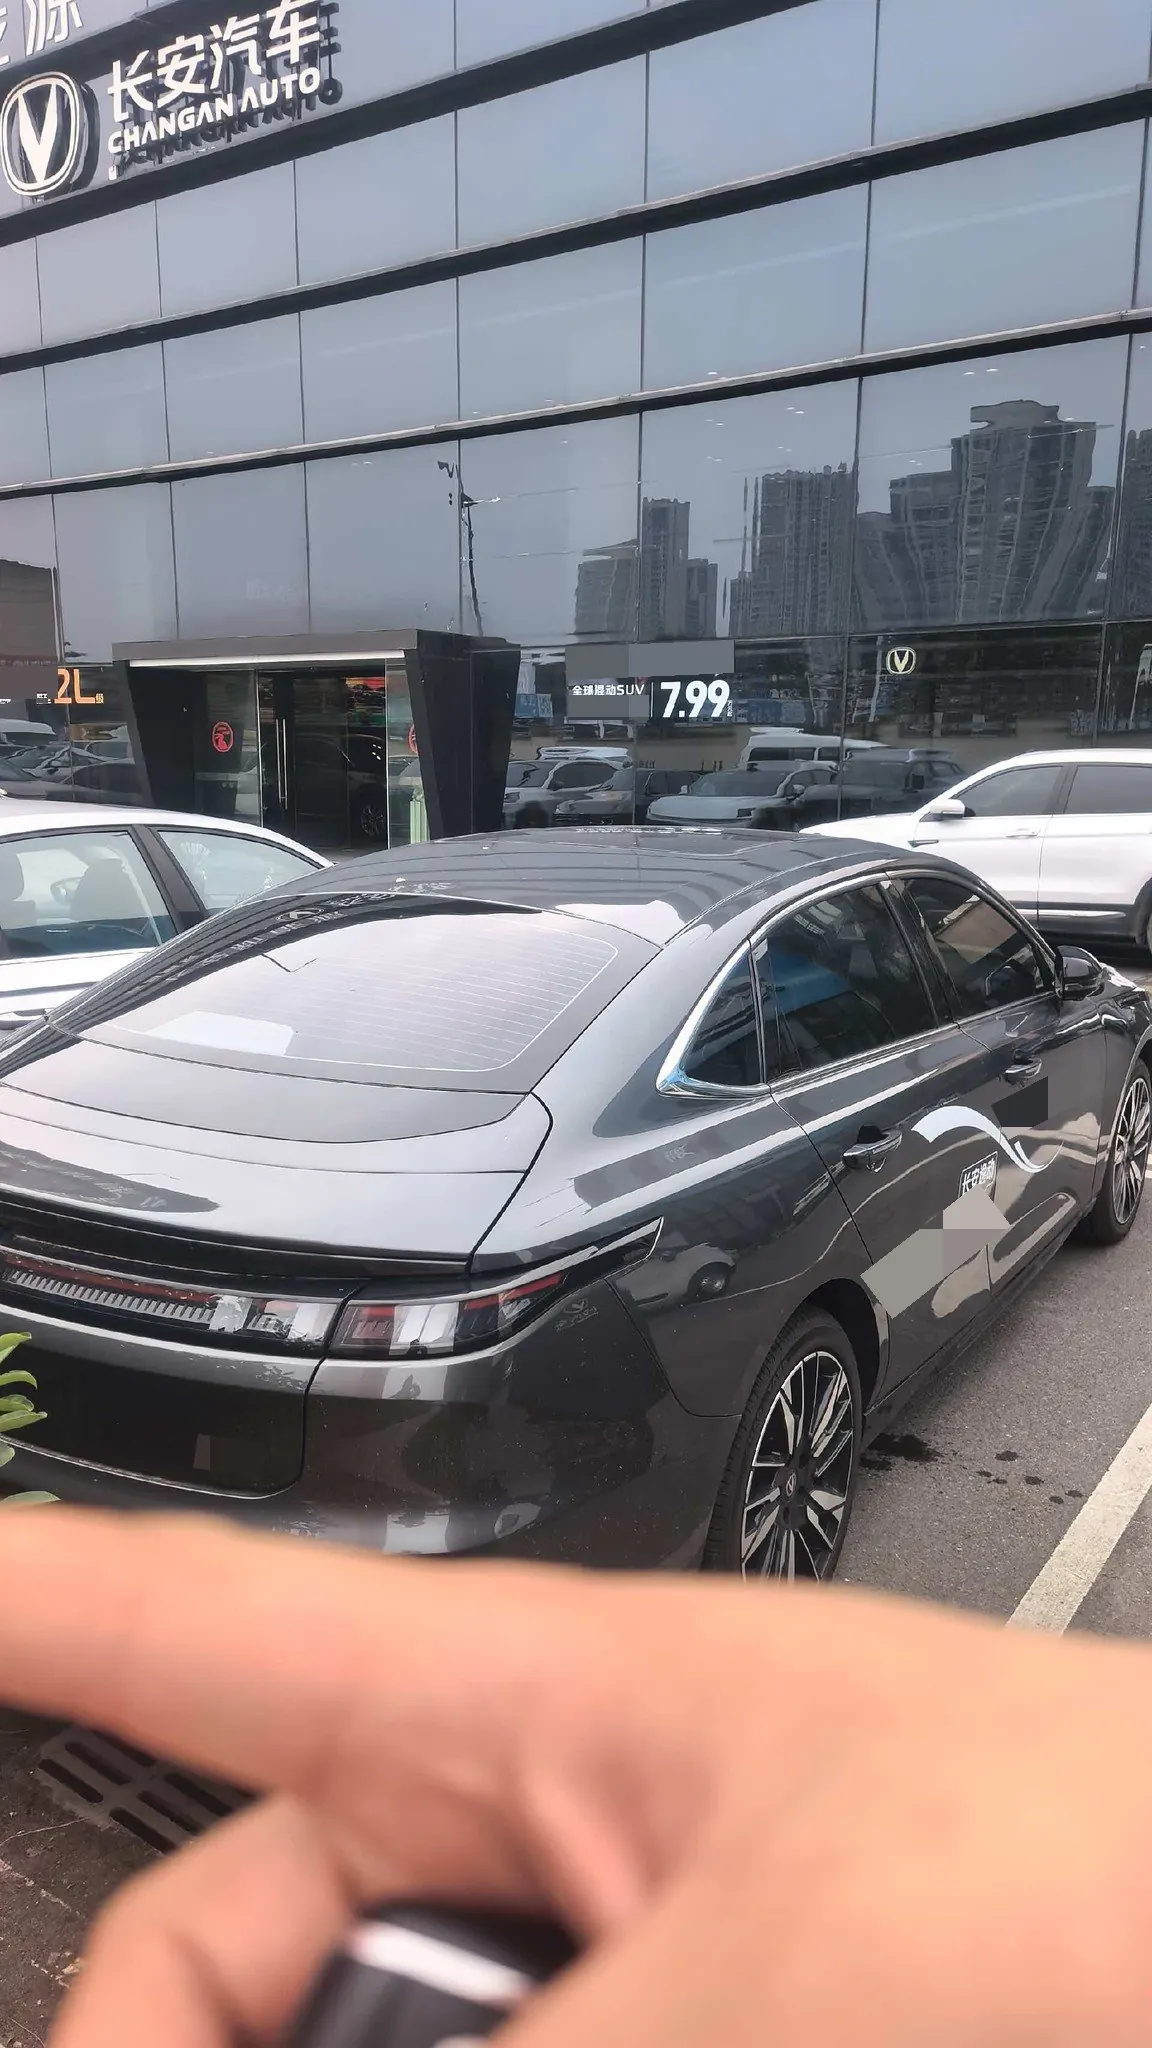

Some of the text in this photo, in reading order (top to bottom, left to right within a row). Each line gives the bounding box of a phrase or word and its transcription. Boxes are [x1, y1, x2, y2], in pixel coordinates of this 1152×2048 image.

[107, 0, 321, 122] 长安汽车
[108, 66, 321, 154] CHANGAN AUTO
[660, 679, 731, 718] 7.99
